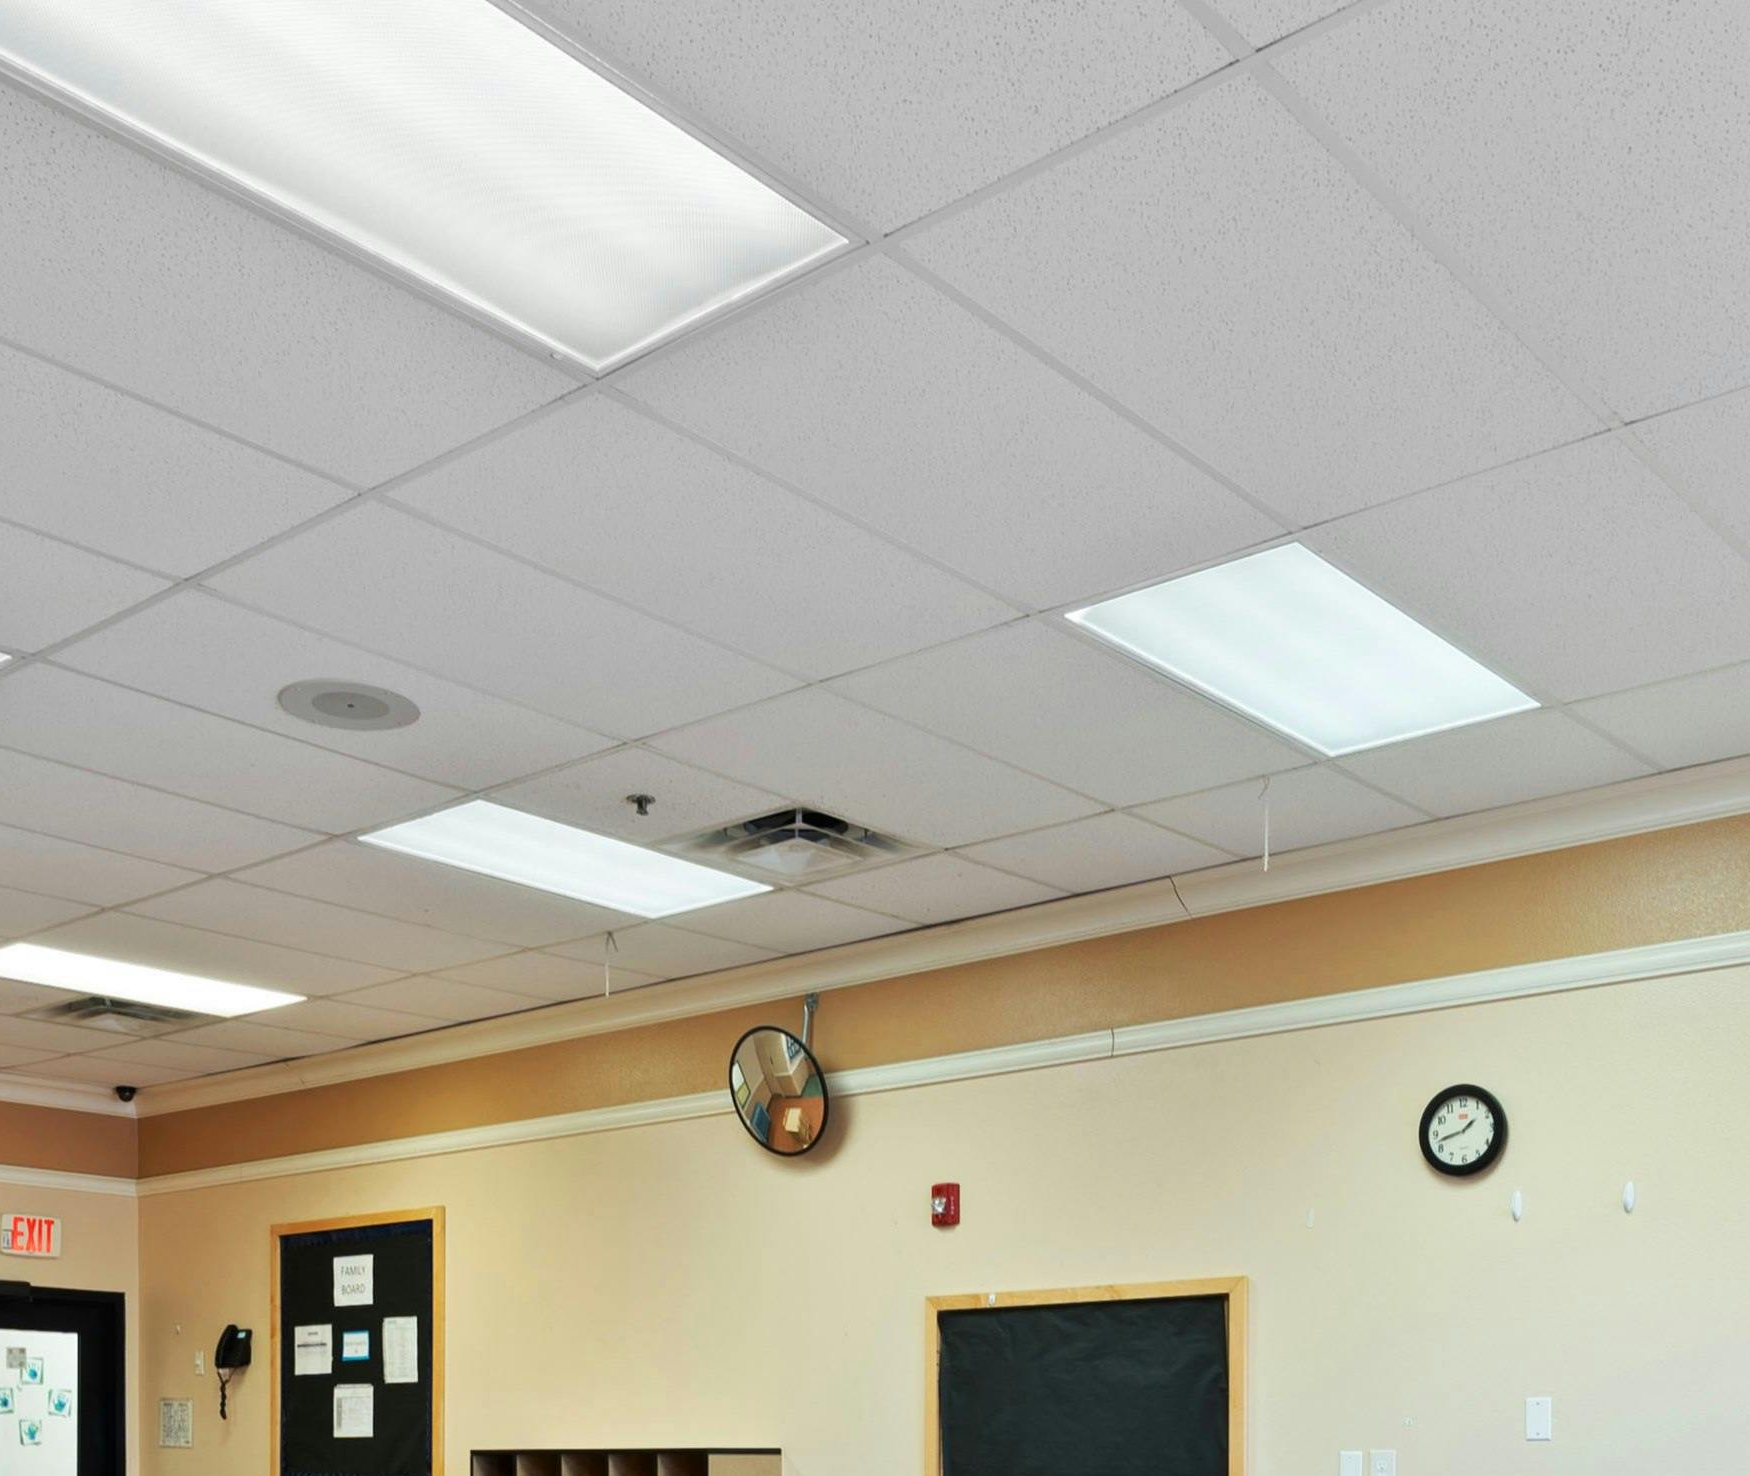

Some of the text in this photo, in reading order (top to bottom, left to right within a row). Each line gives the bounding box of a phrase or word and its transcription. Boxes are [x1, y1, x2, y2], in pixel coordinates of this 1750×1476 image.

[1459, 1097, 1468, 1108] 12
[1447, 1103, 1454, 1113] 11
[1437, 1115, 1447, 1125] 10
[1432, 1130, 1439, 1140] 9
[1438, 1143, 1444, 1153] 8
[12, 1216, 55, 1253] EXIT
[341, 1266, 366, 1276] FAMILY
[341, 1284, 366, 1295] BOARD
